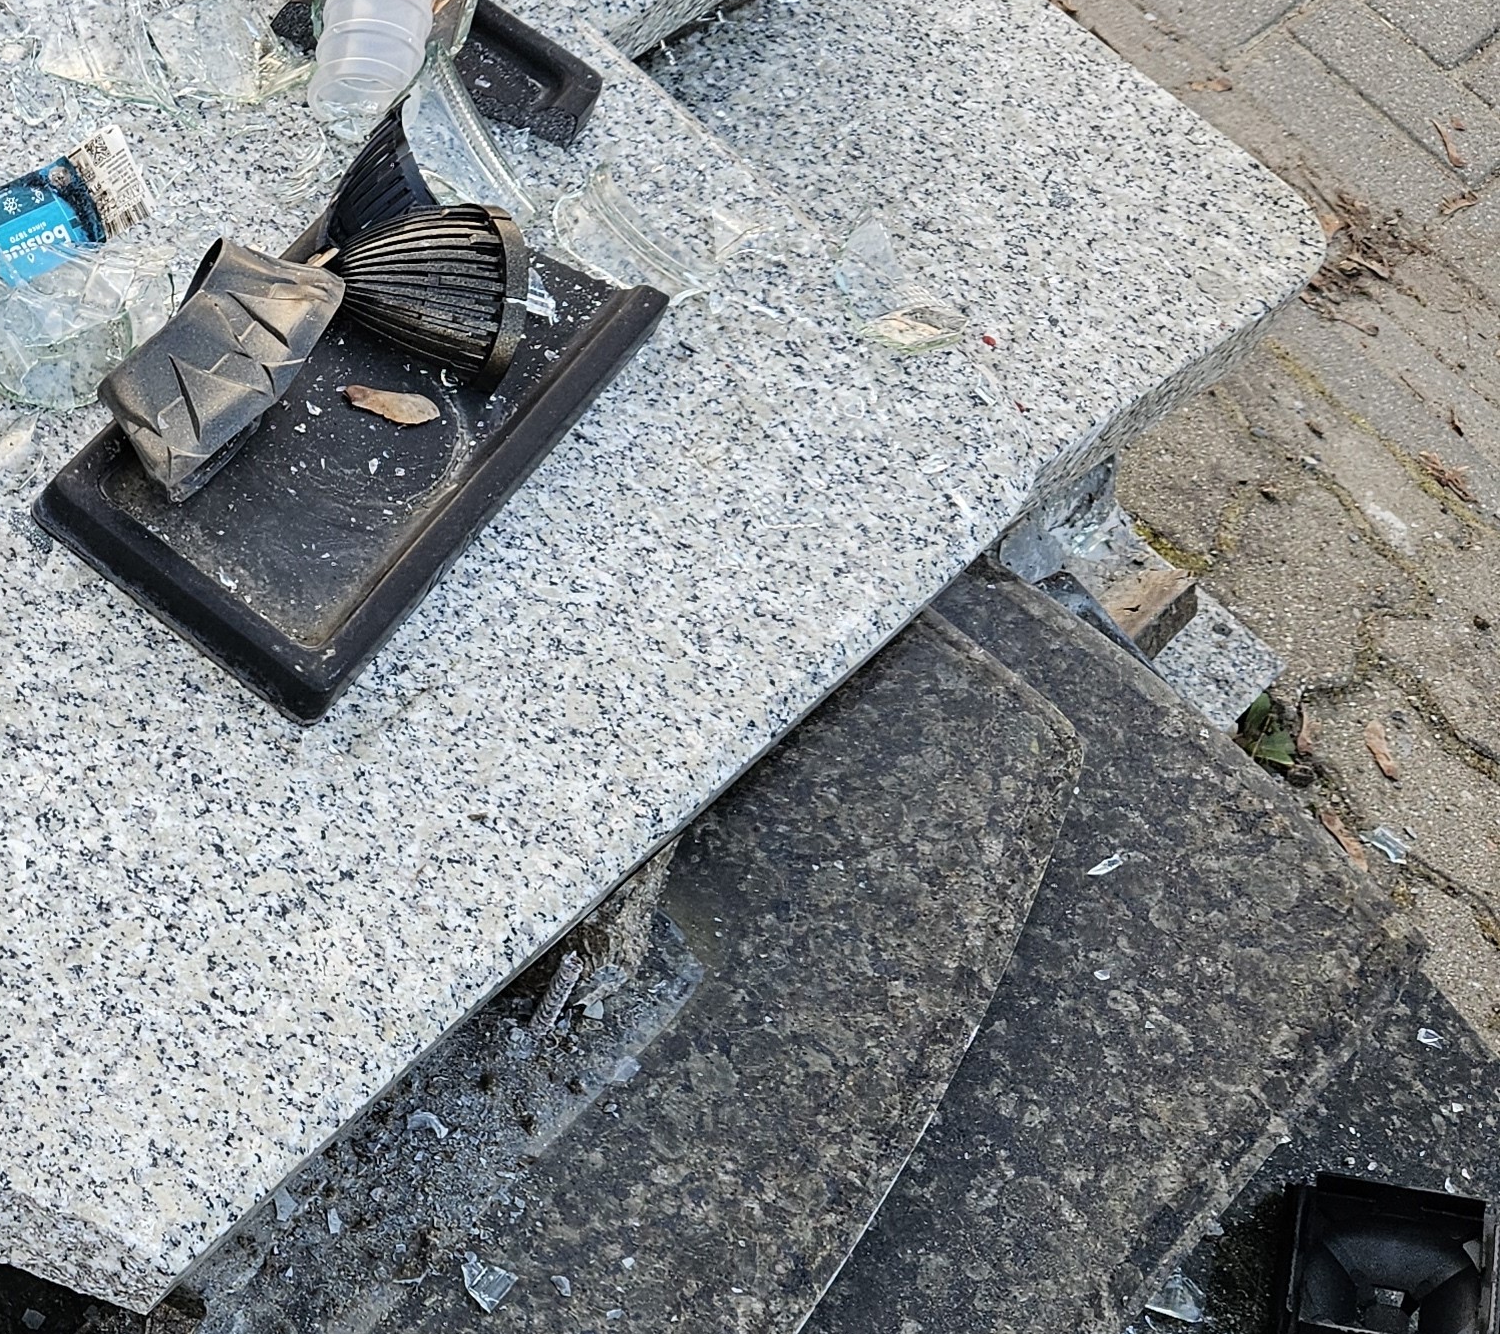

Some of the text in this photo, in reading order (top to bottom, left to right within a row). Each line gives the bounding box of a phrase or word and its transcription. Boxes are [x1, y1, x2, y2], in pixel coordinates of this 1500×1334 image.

[2, 223, 73, 262] bolsius
[9, 221, 47, 244] since 1870
